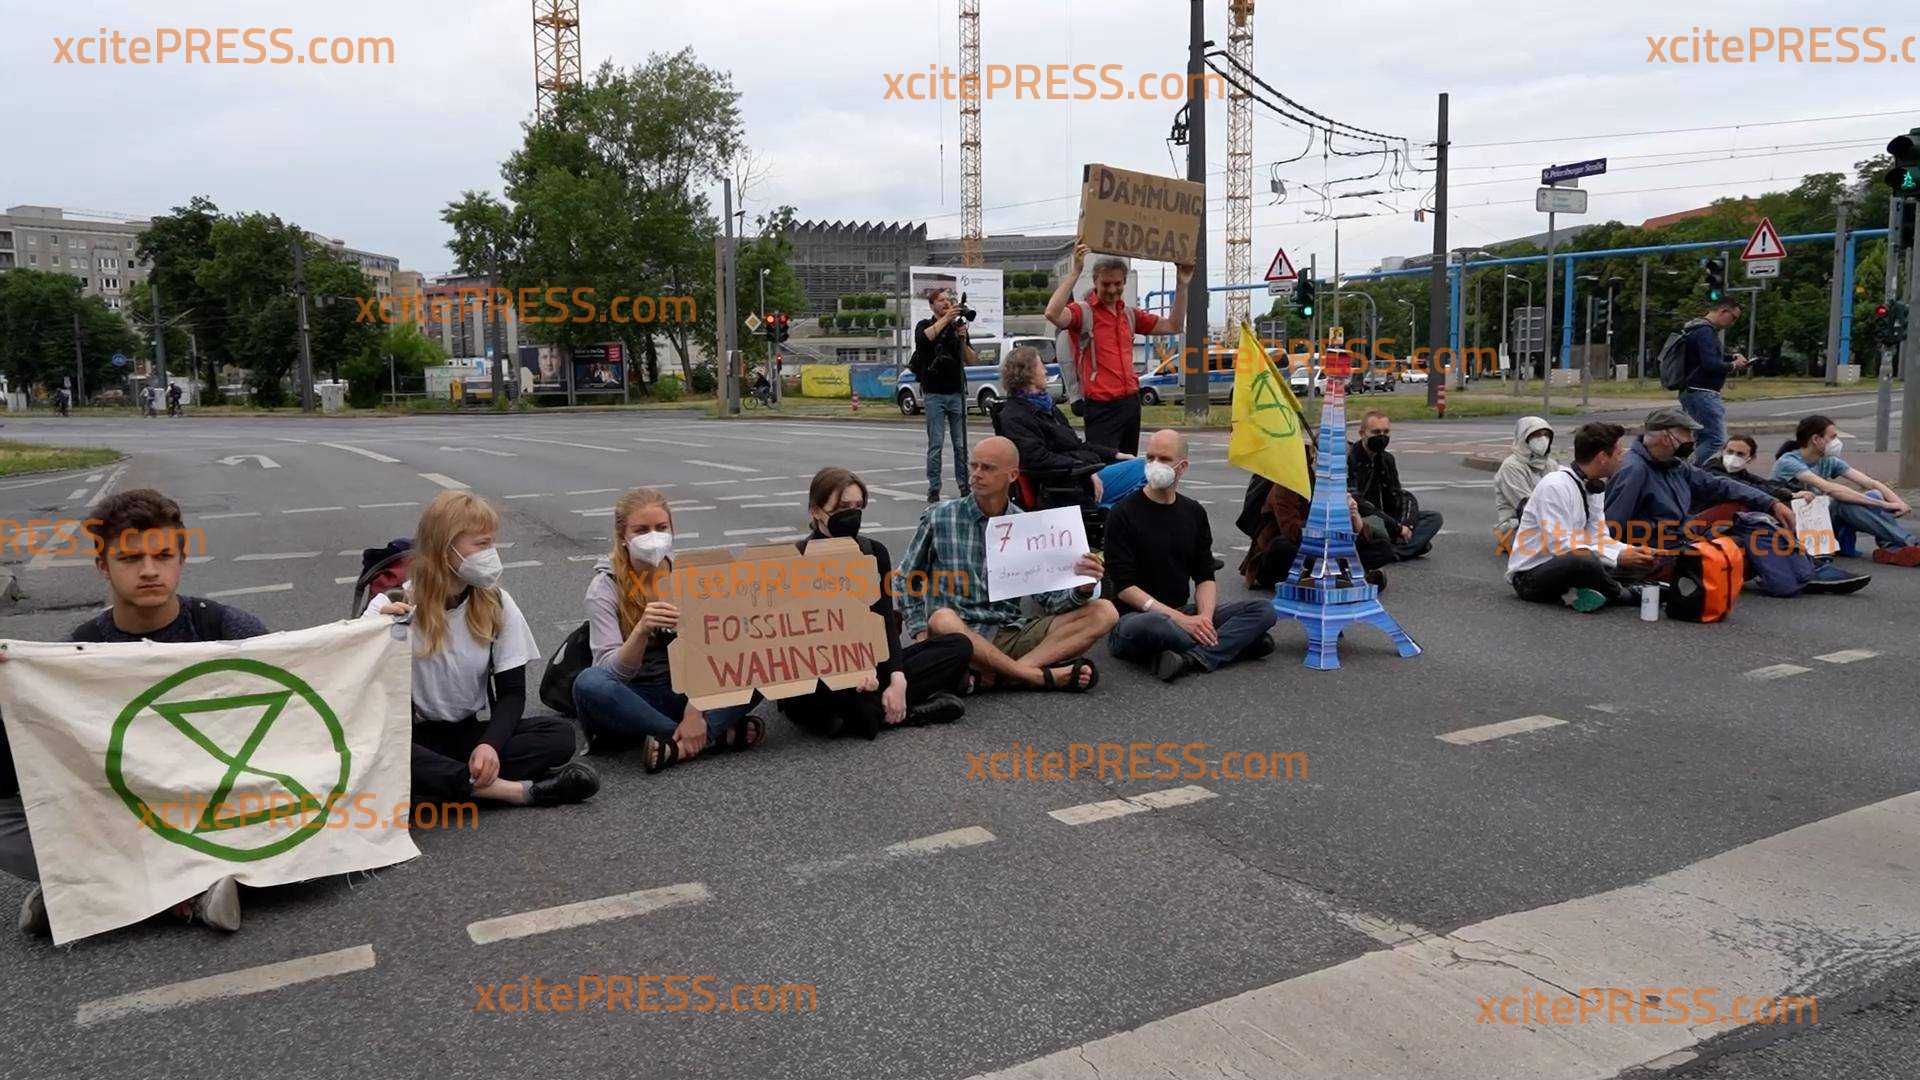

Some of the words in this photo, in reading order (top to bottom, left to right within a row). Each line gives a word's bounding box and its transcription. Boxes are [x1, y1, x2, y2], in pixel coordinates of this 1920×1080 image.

[1102, 220, 1190, 259] ERDGAS
[995, 522, 1013, 553] 7
[1026, 525, 1073, 551] min
[703, 608, 845, 645] FOSSILEN
[707, 641, 877, 687] WAHNSINN
